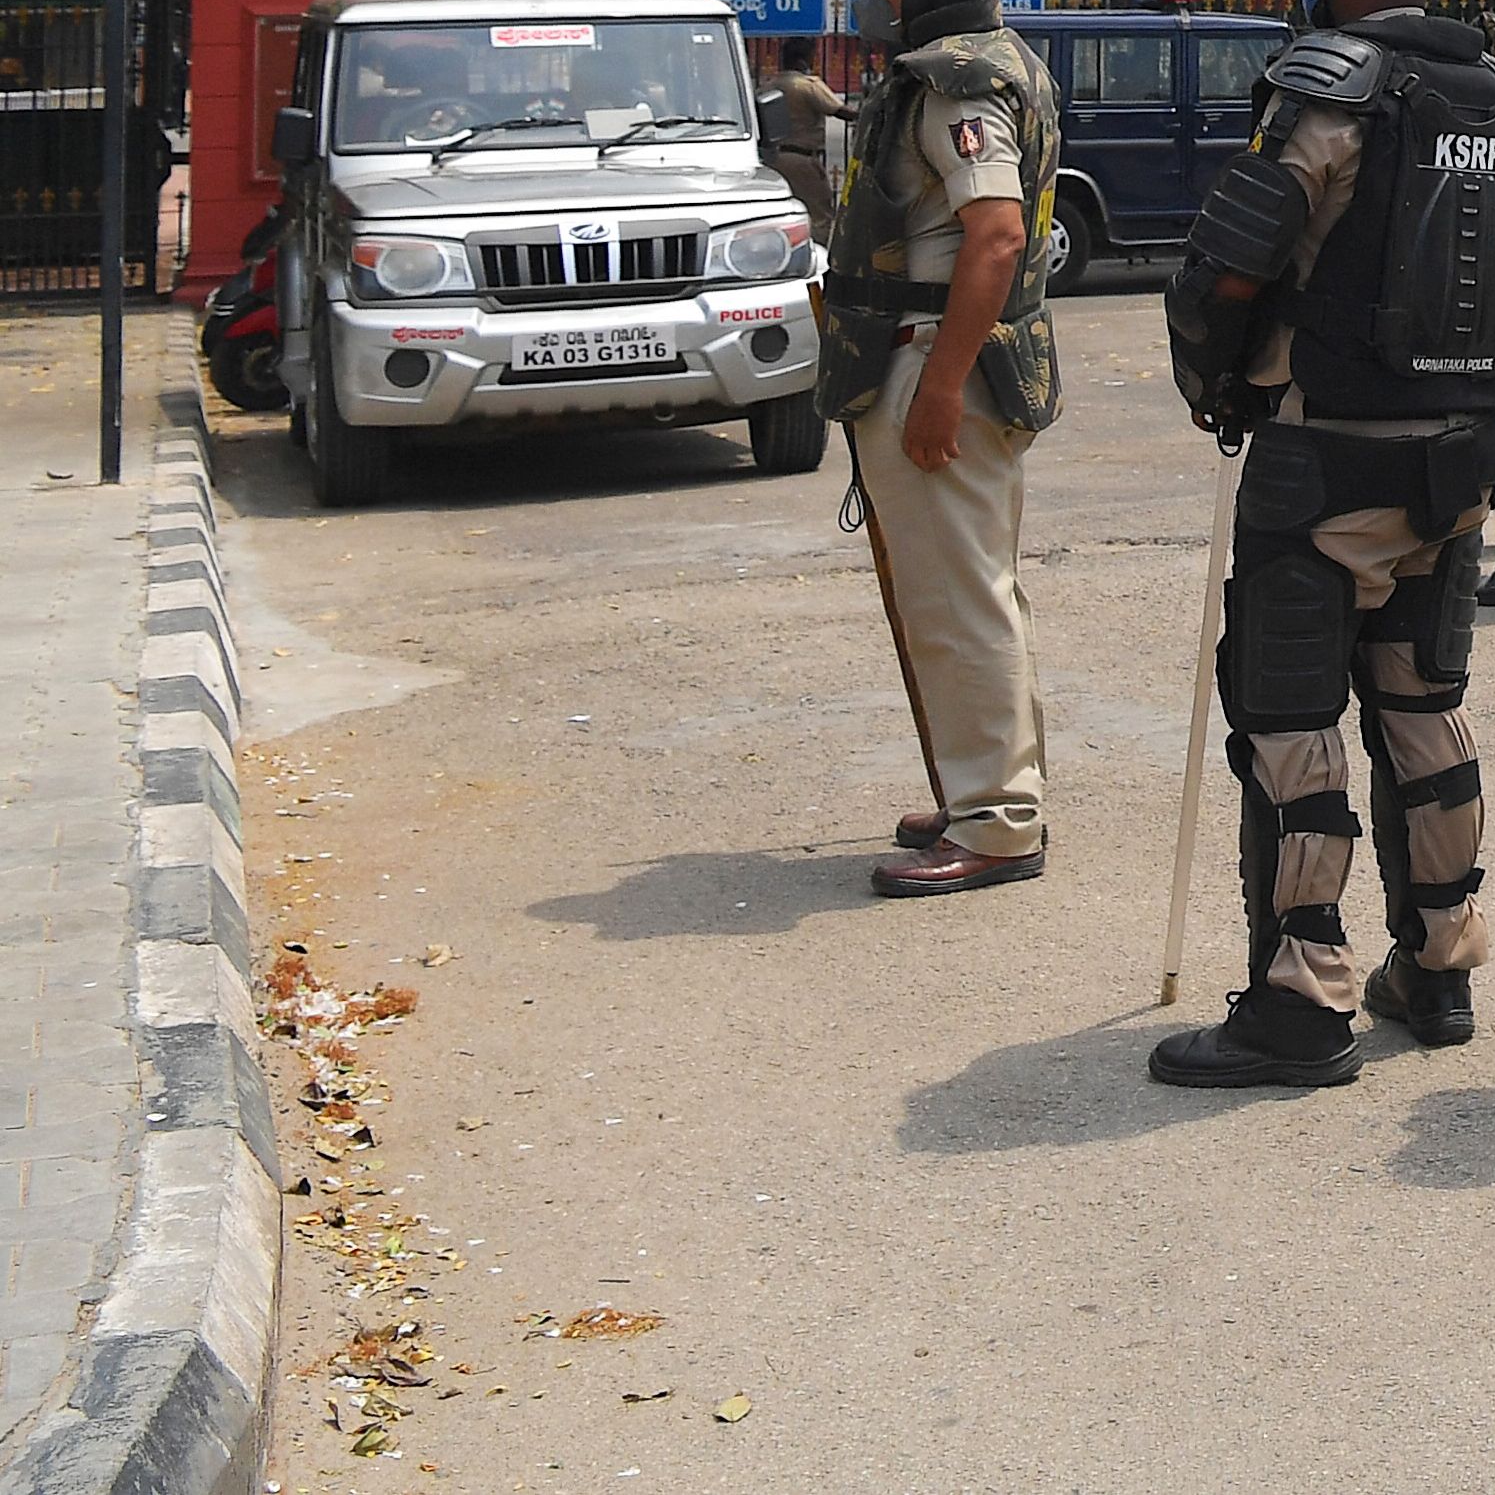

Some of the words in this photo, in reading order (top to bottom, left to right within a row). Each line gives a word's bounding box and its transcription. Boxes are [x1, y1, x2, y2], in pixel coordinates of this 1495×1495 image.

[720, 307, 783, 323] POLICE
[523, 348, 555, 365] KA
[564, 347, 589, 363] 03
[599, 343, 667, 361] G1316
[1412, 357, 1465, 371] KARNATAKA
[1466, 358, 1494, 371] POLICE
